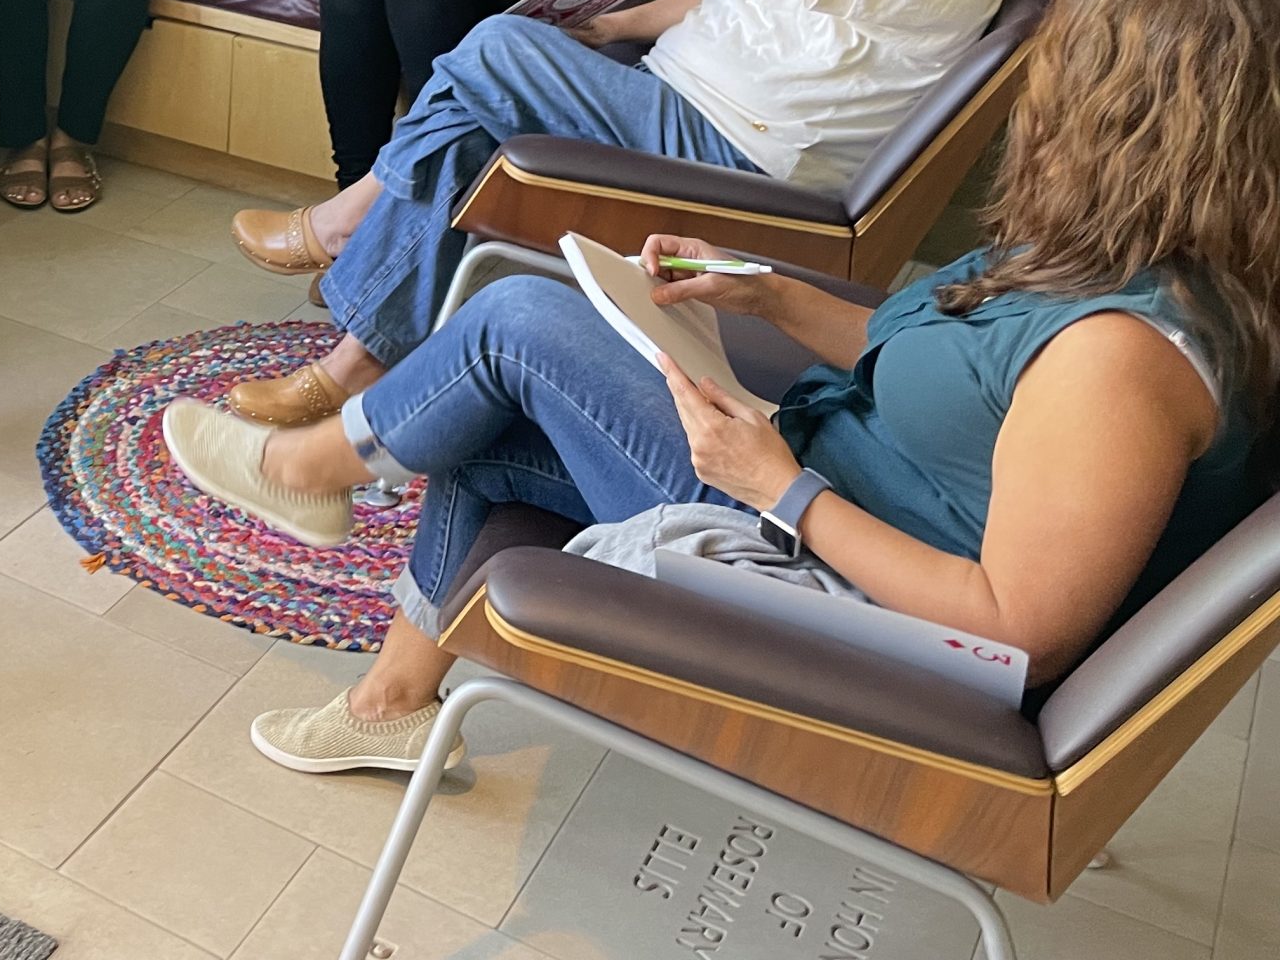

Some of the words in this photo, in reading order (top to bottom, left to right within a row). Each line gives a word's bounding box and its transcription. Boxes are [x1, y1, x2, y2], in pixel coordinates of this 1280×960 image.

[972, 646, 1011, 666] 3
[633, 823, 702, 899] ELLIS
[676, 815, 776, 960] ROSEMARY
[848, 867, 897, 903] IN
[766, 891, 814, 938] OF
